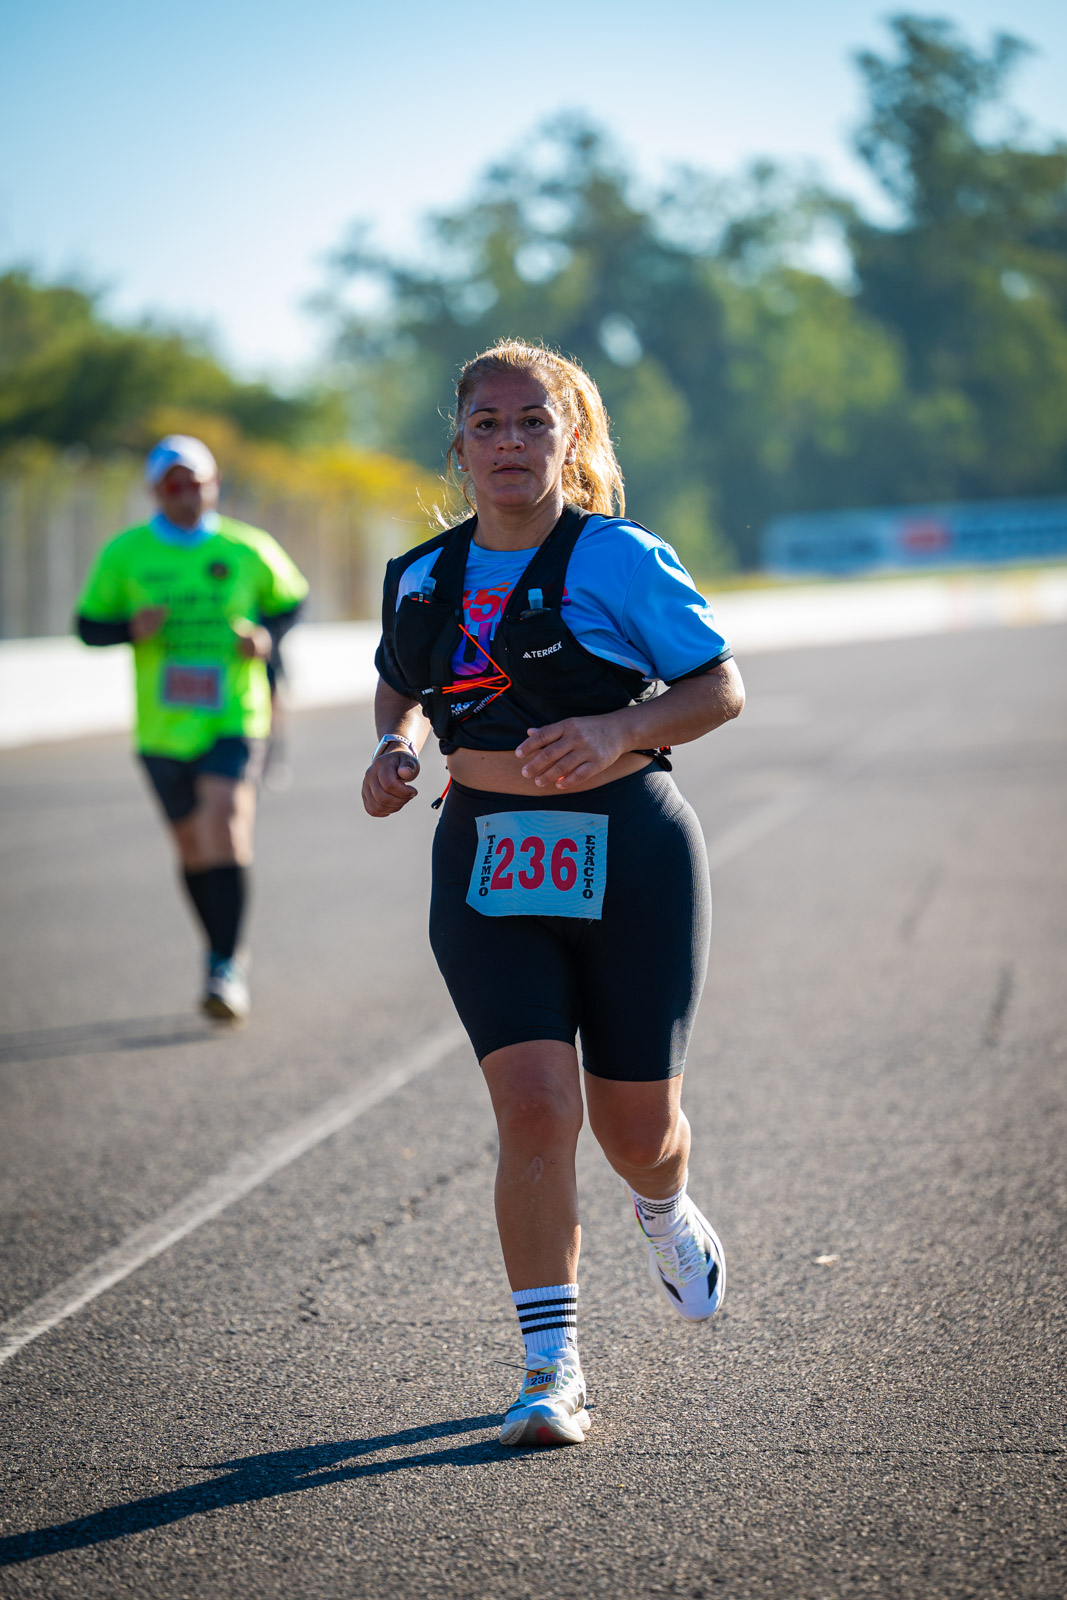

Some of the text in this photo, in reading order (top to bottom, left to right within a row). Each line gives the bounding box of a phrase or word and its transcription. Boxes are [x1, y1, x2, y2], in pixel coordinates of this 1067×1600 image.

[530, 641, 563, 658] TERREX
[478, 834, 496, 897] TIEMPO
[490, 836, 578, 892] 236
[582, 834, 596, 899] EXACTO
[531, 1374, 552, 1385] 236
